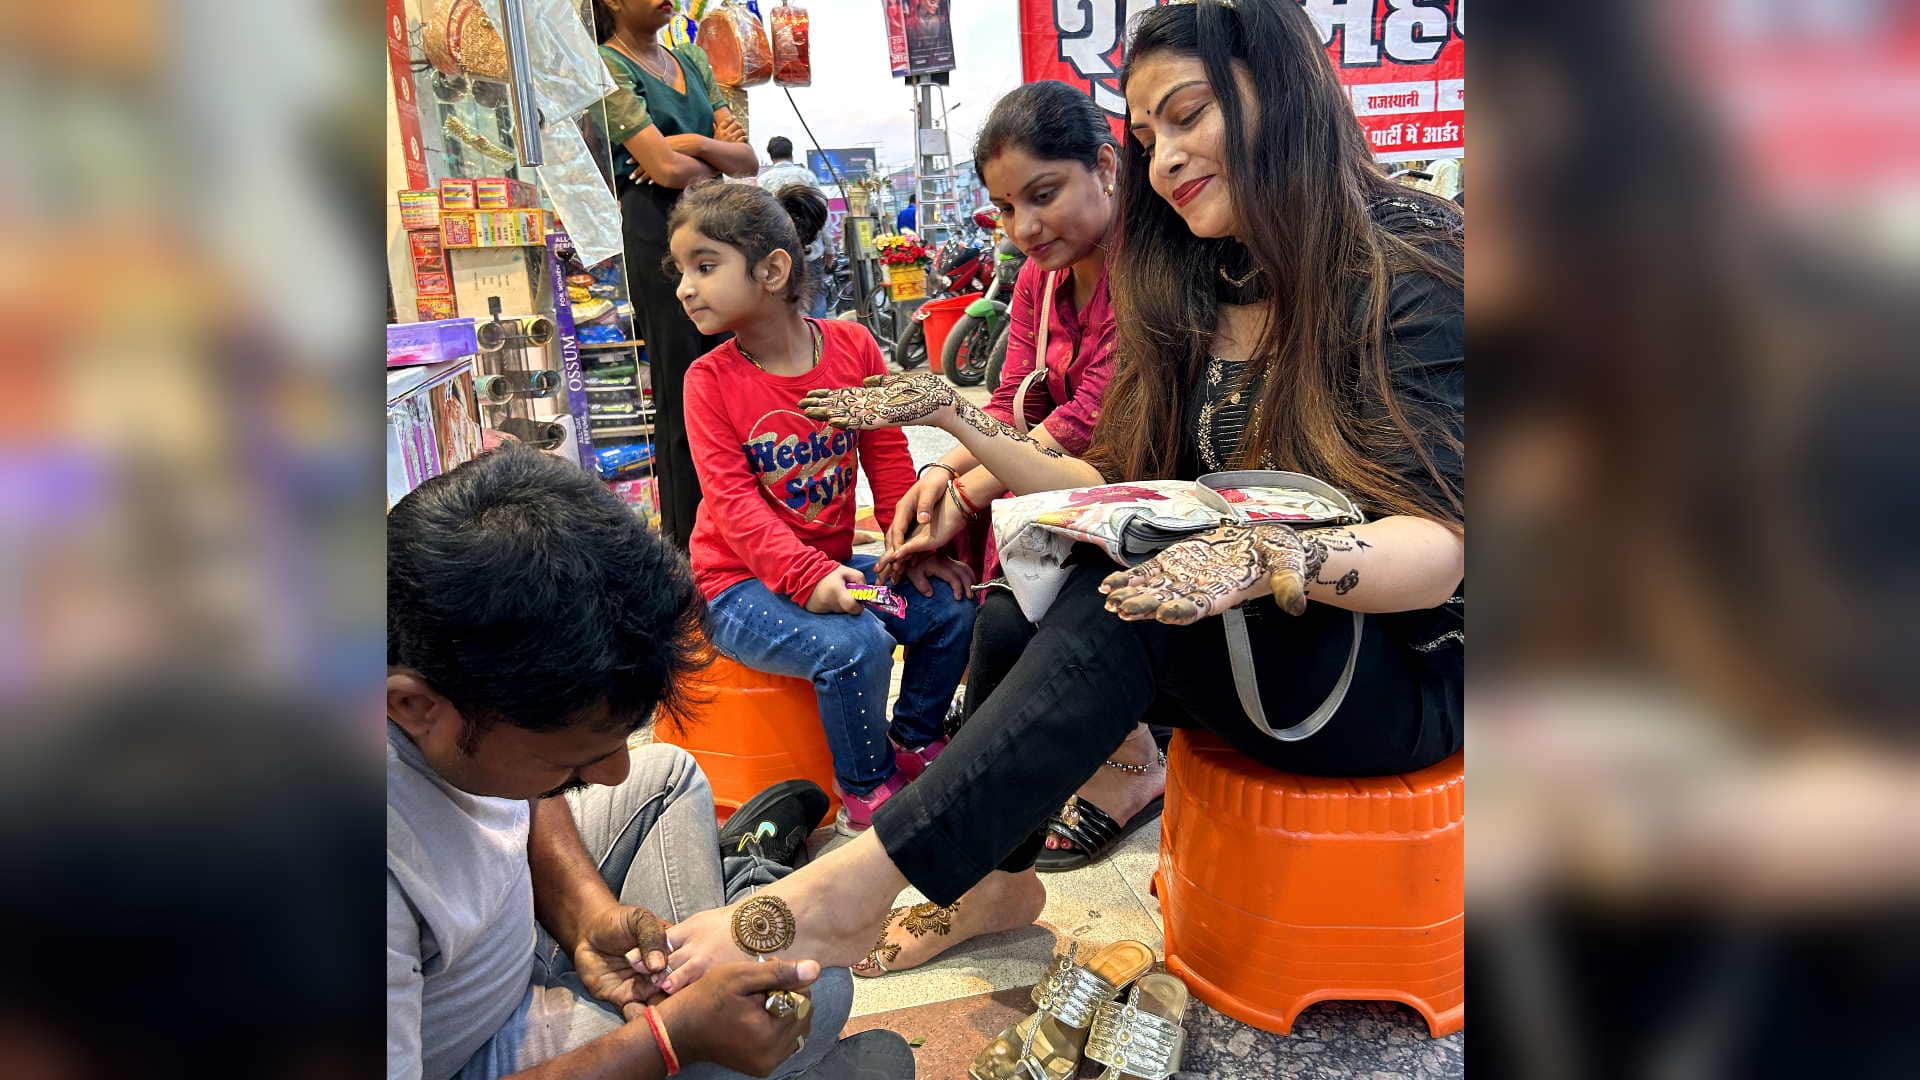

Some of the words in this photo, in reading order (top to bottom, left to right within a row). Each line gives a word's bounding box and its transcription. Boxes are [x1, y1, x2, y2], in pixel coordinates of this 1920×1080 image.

[1367, 90, 1420, 109] राजस्थानी
[1371, 123, 1404, 146] पार्टी
[1406, 122, 1420, 144] में
[562, 335, 582, 392] OSSUM
